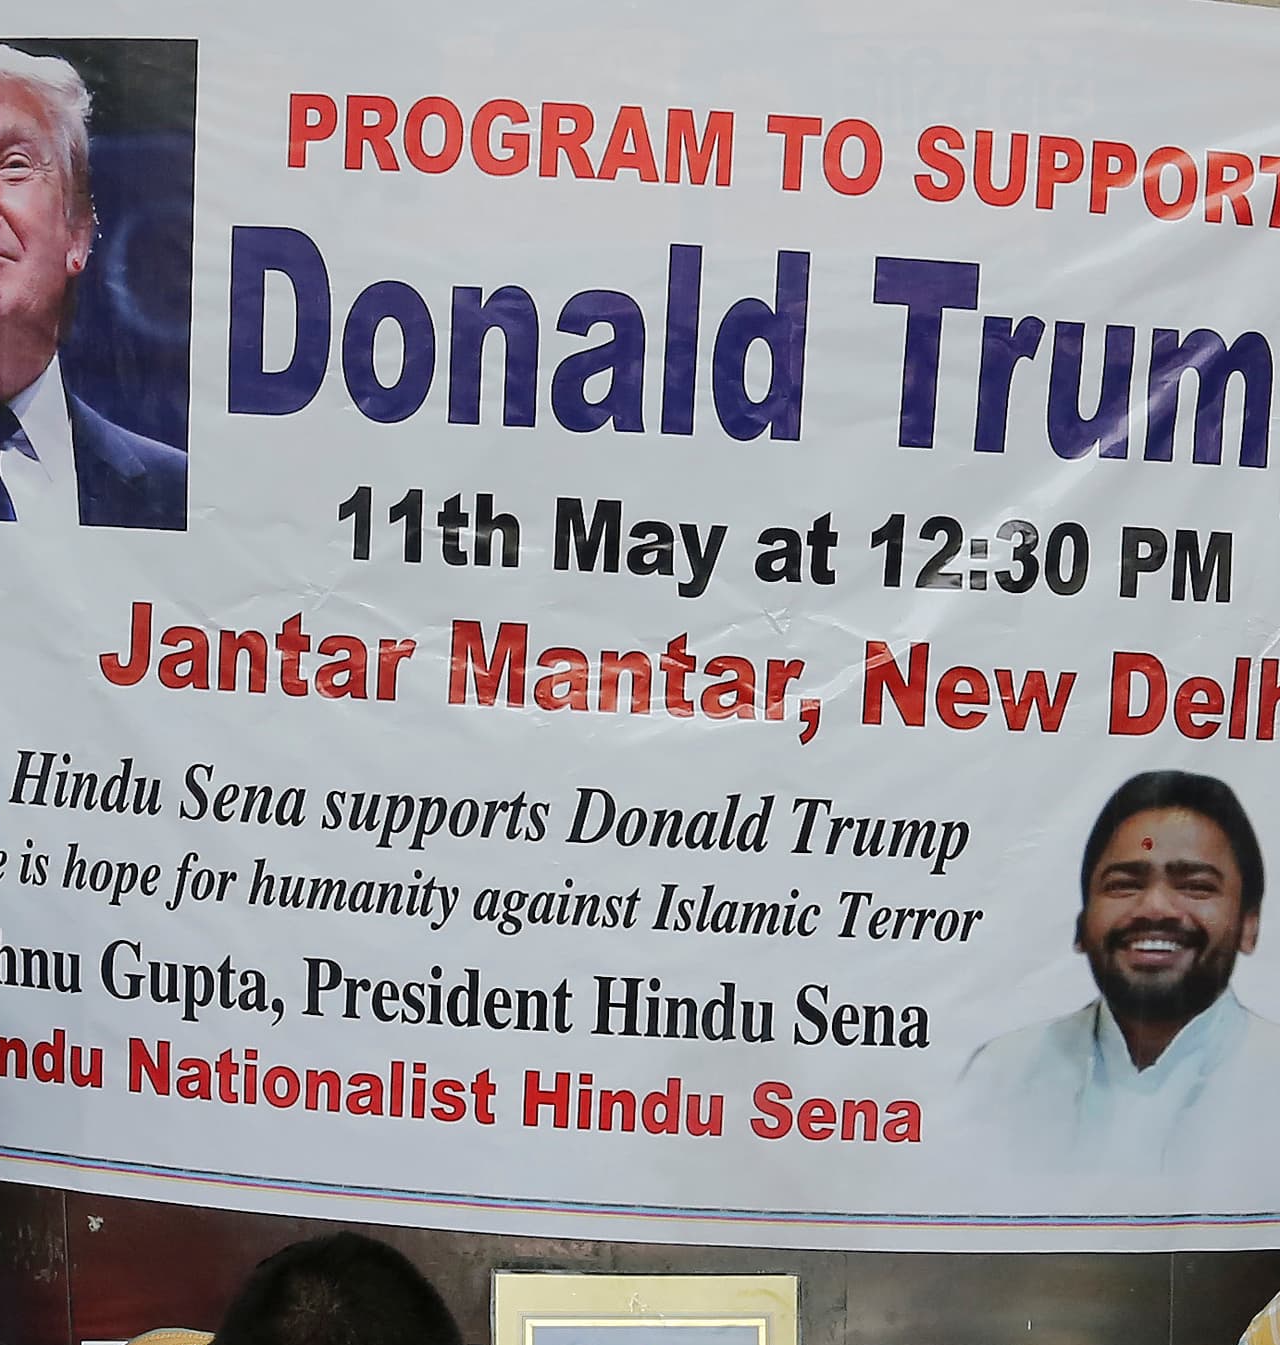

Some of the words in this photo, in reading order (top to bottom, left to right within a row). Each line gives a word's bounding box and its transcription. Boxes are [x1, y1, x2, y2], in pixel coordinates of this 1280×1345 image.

[287, 93, 734, 187] PROGRAM
[766, 114, 883, 196] TO
[227, 225, 811, 442] Donald
[338, 485, 520, 568] 11th
[553, 497, 729, 599] May
[754, 511, 839, 586] at
[870, 513, 1090, 596] 12:30
[1119, 526, 1233, 603] PM
[98, 601, 417, 702] Jantar
[447, 619, 821, 746] Mantar,
[861, 640, 1078, 733] New
[8, 750, 162, 816] Hindu
[179, 763, 307, 827] Sena
[321, 787, 551, 852] supports
[564, 787, 775, 854] Donald
[790, 798, 970, 876] Trump
[19, 838, 50, 886] is
[62, 848, 161, 907] hope
[165, 851, 238, 911] for
[248, 858, 460, 929] humanity
[473, 878, 642, 936] against
[651, 883, 821, 937] Islamic
[837, 891, 984, 942] Terror
[100, 939, 285, 1026] Gupta,
[301, 957, 574, 1034] President
[590, 975, 776, 1044] Hindu
[793, 990, 930, 1049] Sena
[128, 1037, 497, 1125] Nationalist
[522, 1069, 724, 1137] Hindu
[749, 1081, 921, 1143] Sena
